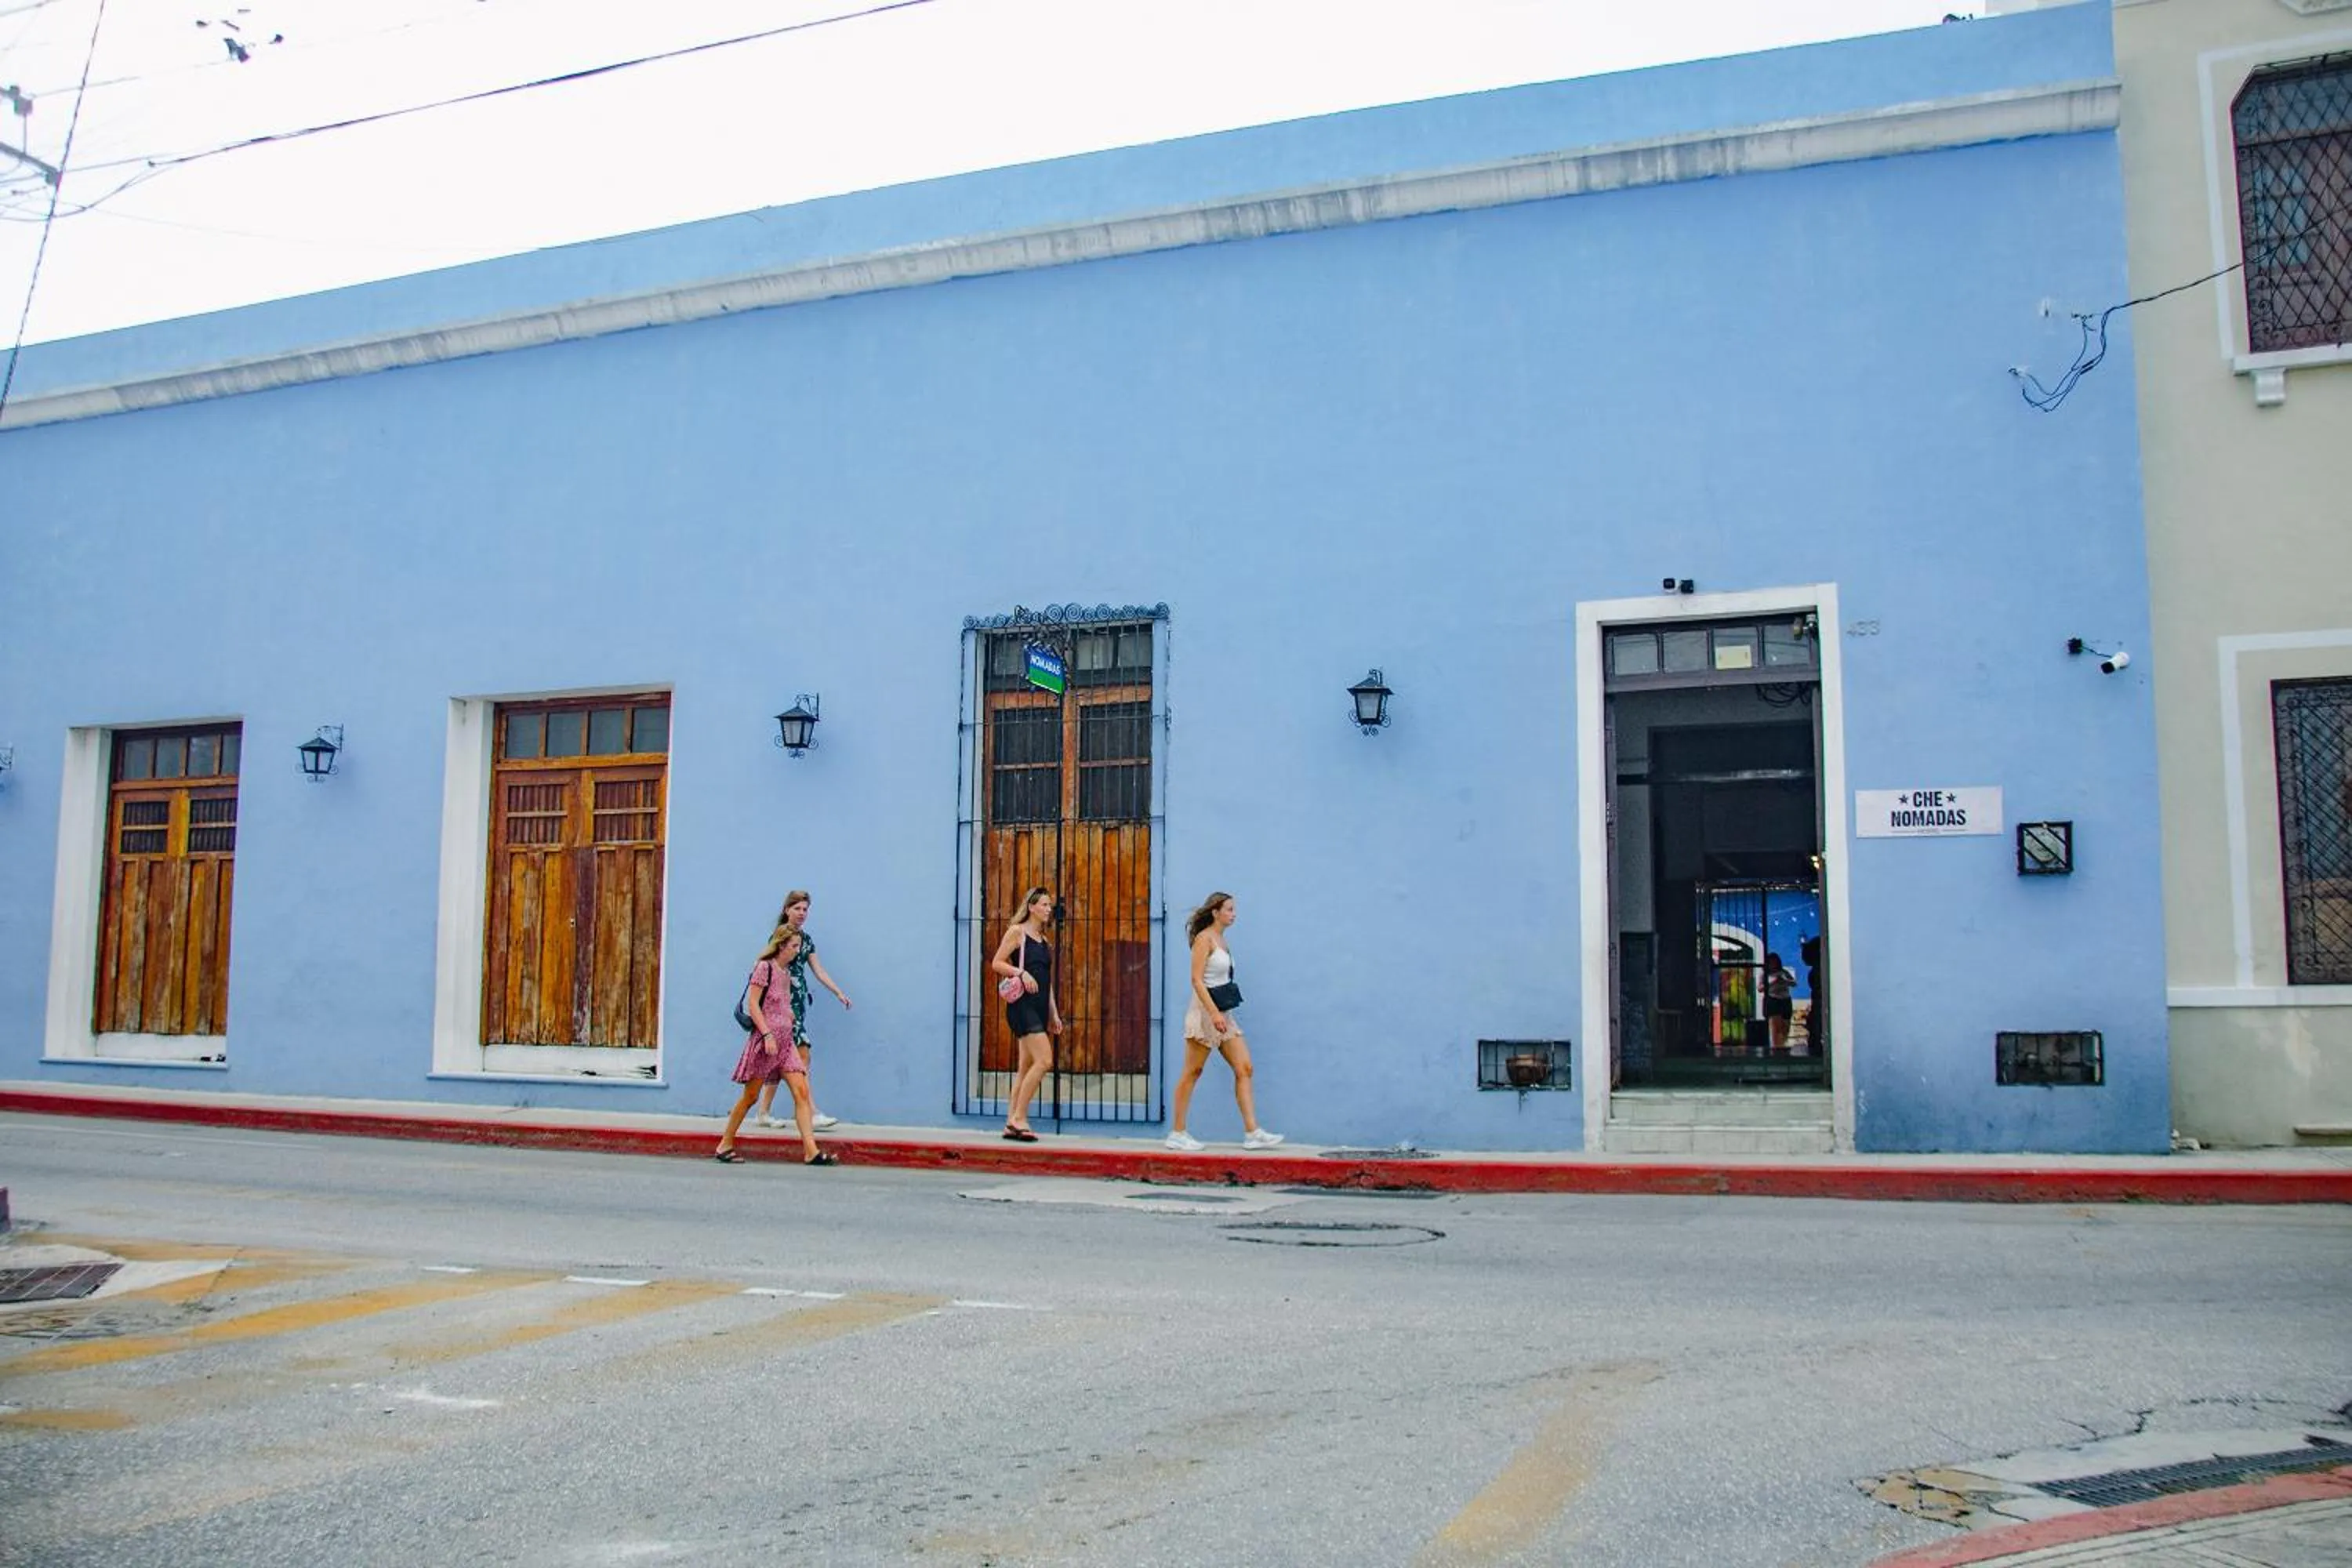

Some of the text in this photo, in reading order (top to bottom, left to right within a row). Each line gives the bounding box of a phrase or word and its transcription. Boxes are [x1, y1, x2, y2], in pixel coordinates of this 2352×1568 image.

[1030, 655, 1061, 675] NOMADAS
[1914, 791, 1943, 807] CHE
[1891, 810, 1966, 826] NOMADAS
